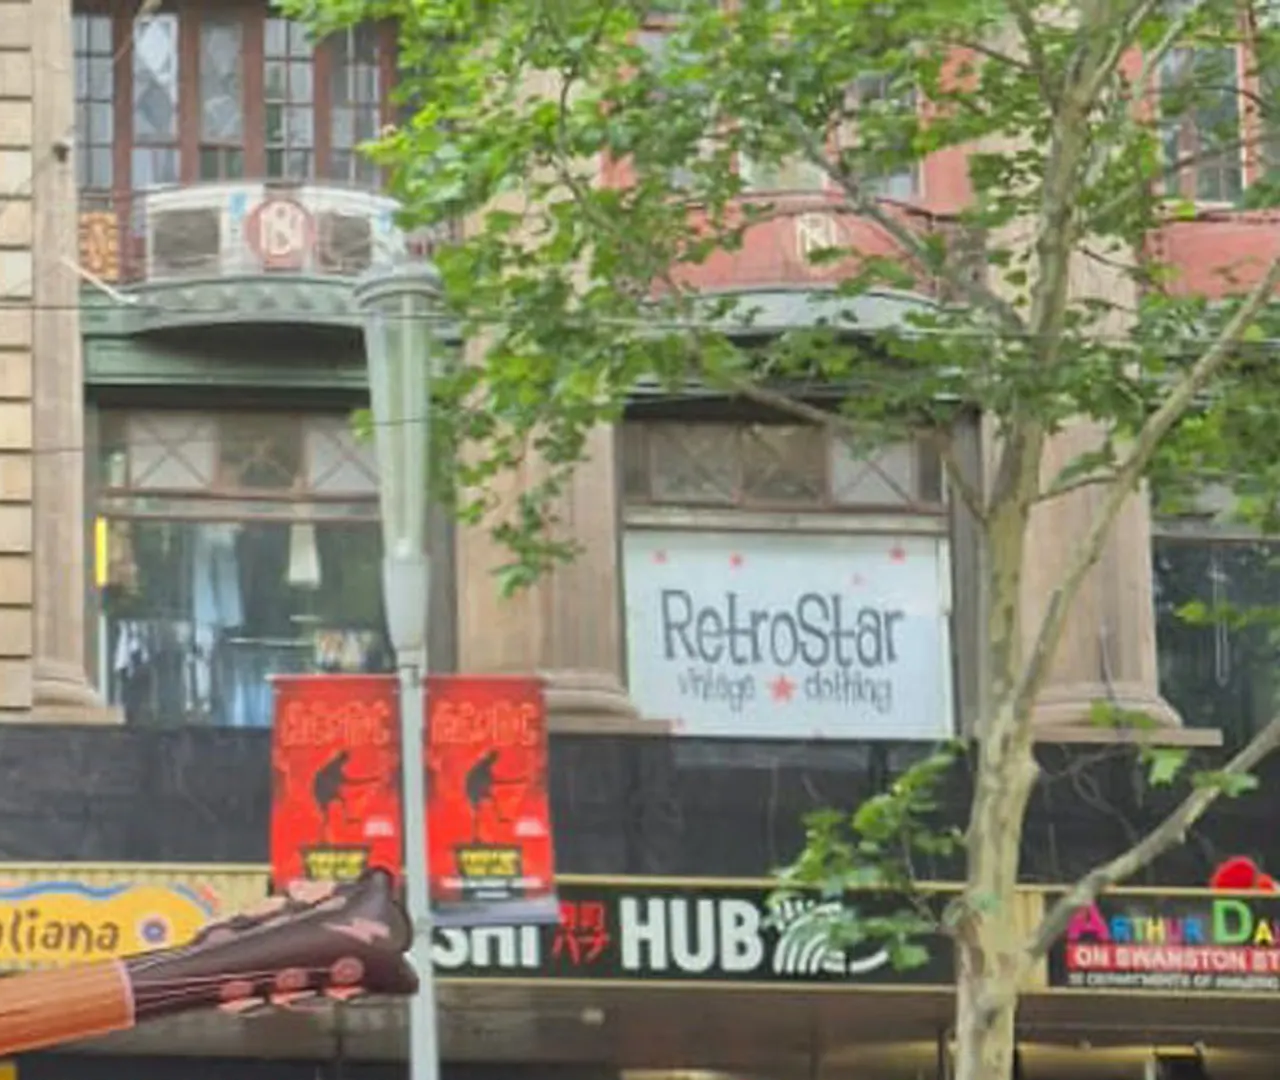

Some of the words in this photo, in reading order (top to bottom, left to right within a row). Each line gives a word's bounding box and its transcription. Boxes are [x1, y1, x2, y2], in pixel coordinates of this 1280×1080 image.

[661, 588, 905, 668] RetroStar
[678, 667, 756, 713] vintage
[804, 666, 893, 714] clothing
[620, 896, 763, 971] HUB
[1066, 901, 1207, 942] ARTHUR
[1076, 947, 1109, 971] ON
[1116, 948, 1246, 972] SWANSTON
